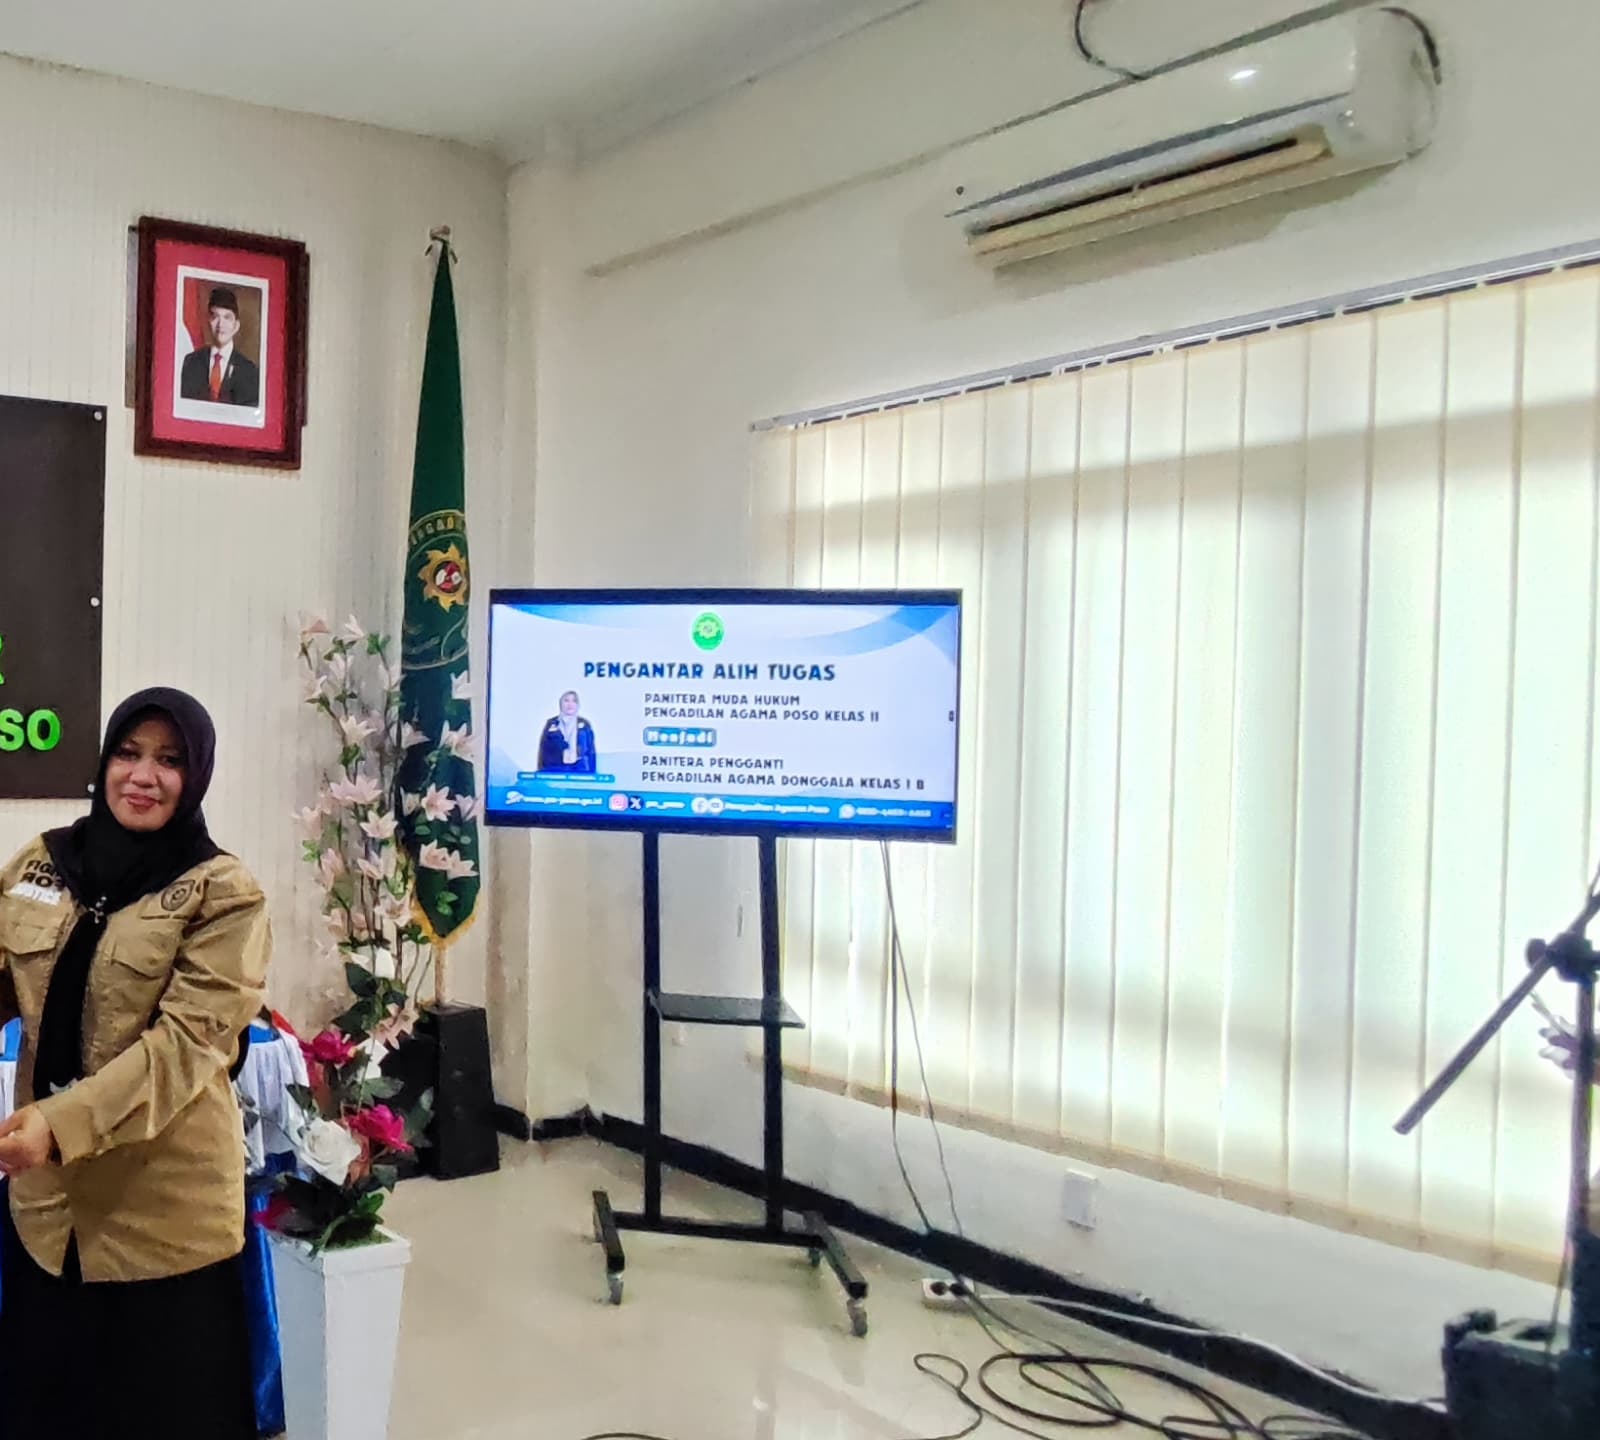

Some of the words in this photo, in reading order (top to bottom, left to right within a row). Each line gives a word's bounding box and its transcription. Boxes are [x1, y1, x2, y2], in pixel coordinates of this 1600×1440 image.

[584, 662, 703, 678] PENGANTAR
[713, 663, 758, 680] ALIH
[768, 664, 836, 681] TUGAS
[644, 693, 706, 704] PANITERA
[712, 694, 748, 705] MUDA
[754, 695, 800, 706] HUKUM
[644, 707, 724, 718] PENGADILAN
[730, 708, 778, 720] AGAMA
[783, 710, 819, 721] POSO
[825, 710, 865, 721] KELAS
[642, 755, 704, 767] PANITERA
[710, 757, 784, 769] PENGGANTI
[642, 771, 722, 783] PENGADILAN
[728, 774, 775, 785] AGAMA
[781, 775, 854, 787] DONGGALA
[860, 777, 900, 789] KELAS
